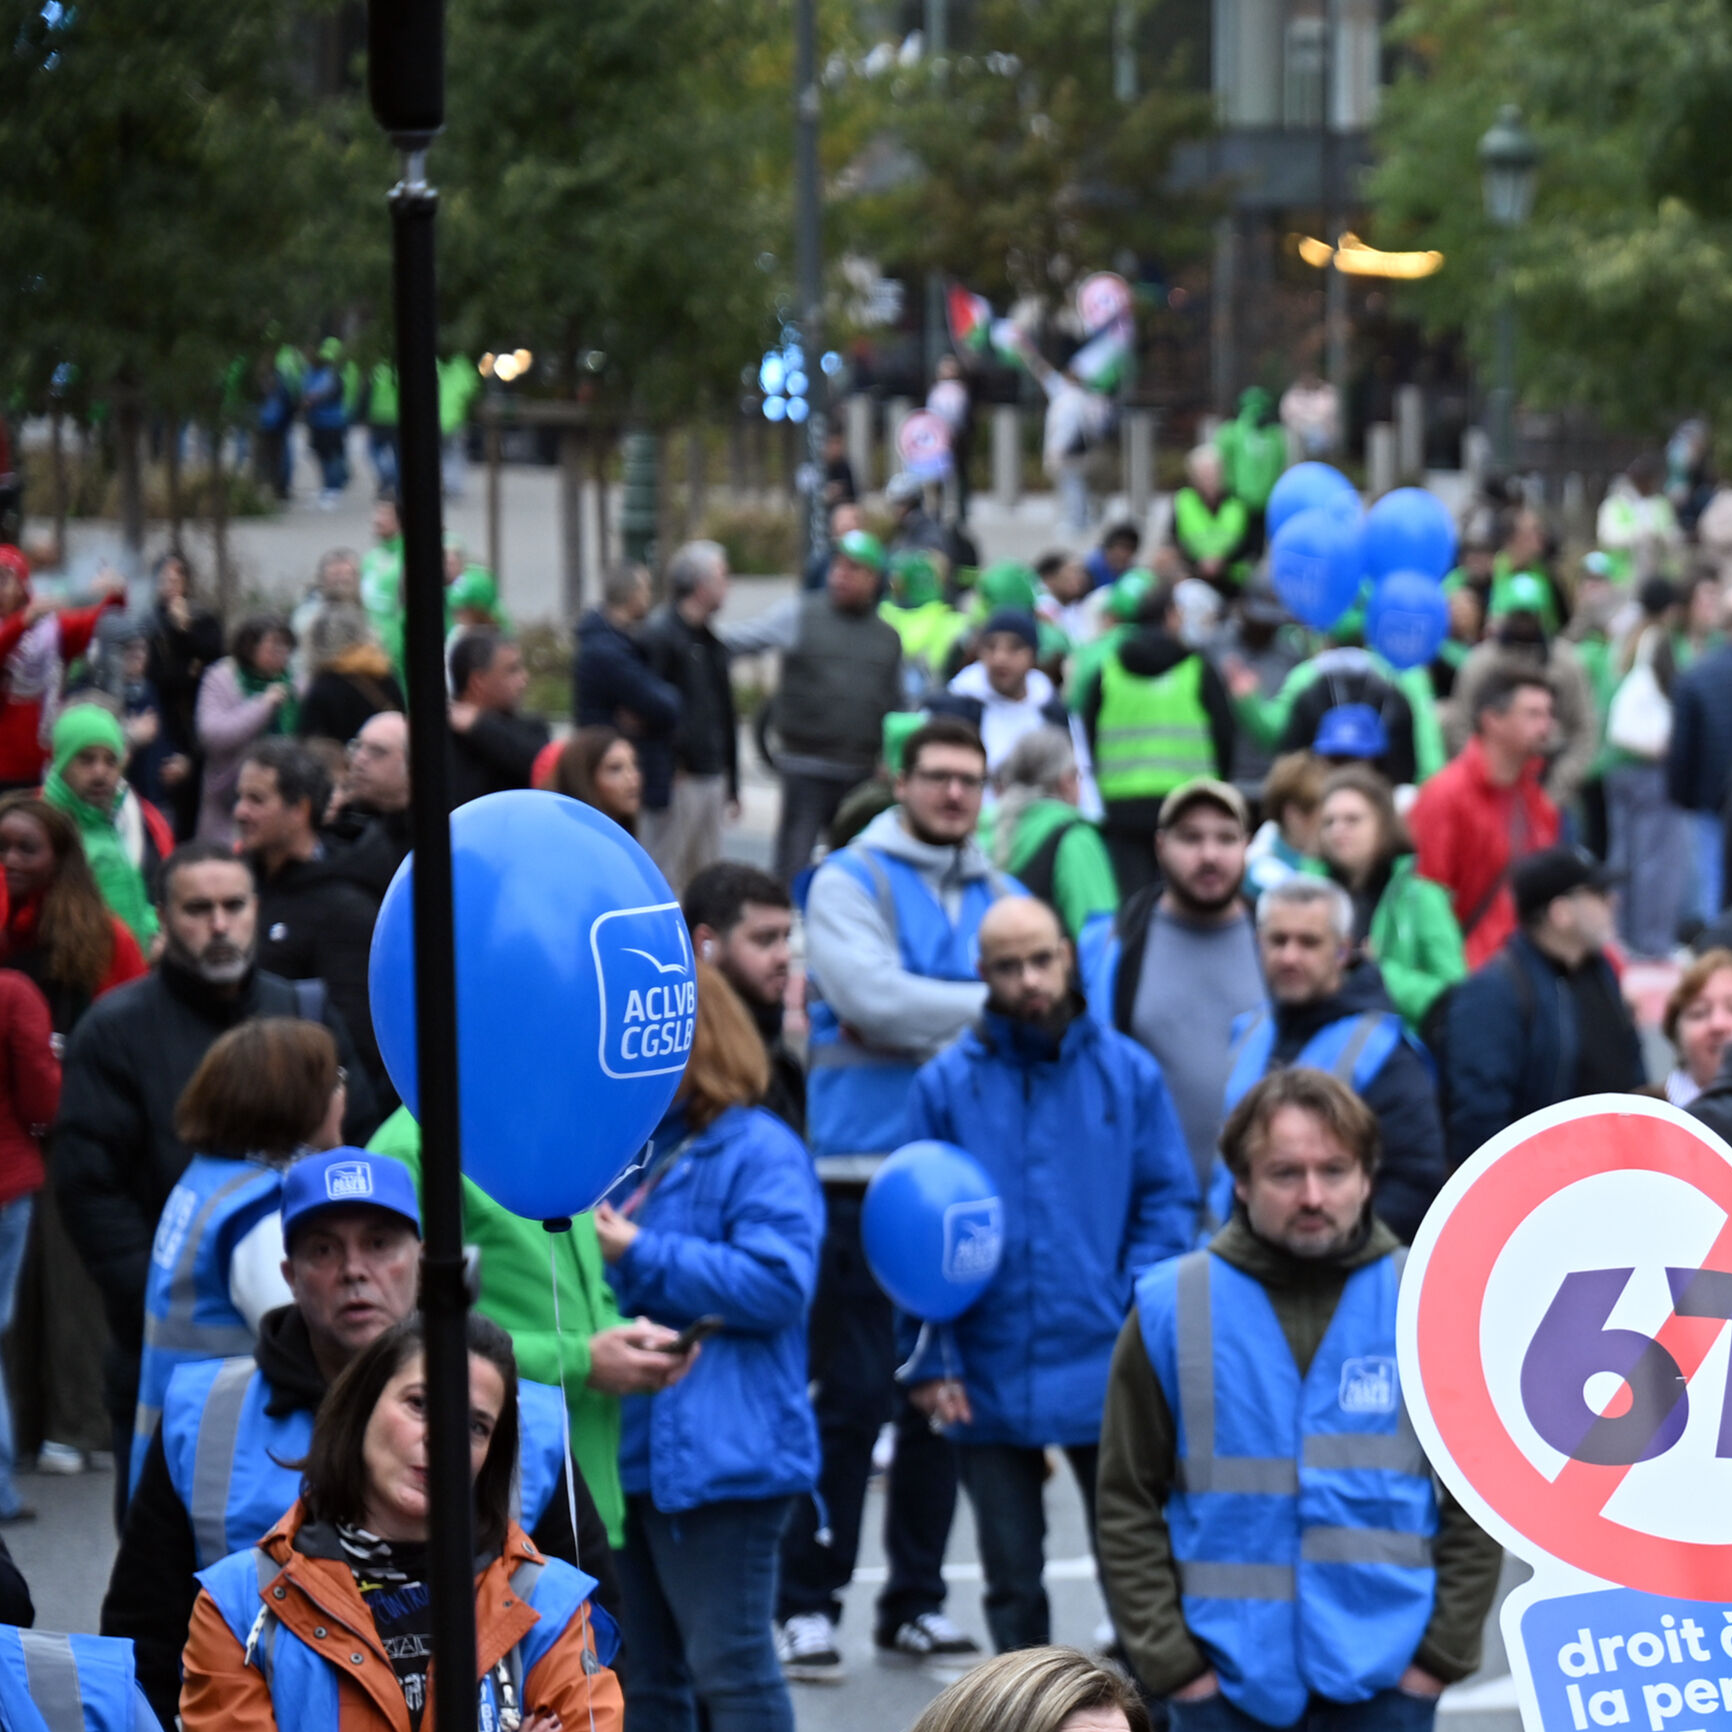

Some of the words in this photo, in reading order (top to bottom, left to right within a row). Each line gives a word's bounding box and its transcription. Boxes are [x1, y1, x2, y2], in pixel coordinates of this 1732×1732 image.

[623, 981, 695, 1024] ACLVB
[620, 1018, 694, 1060] CGSLB
[1557, 1614, 1711, 1678] droit
[1566, 1683, 1630, 1731] la
